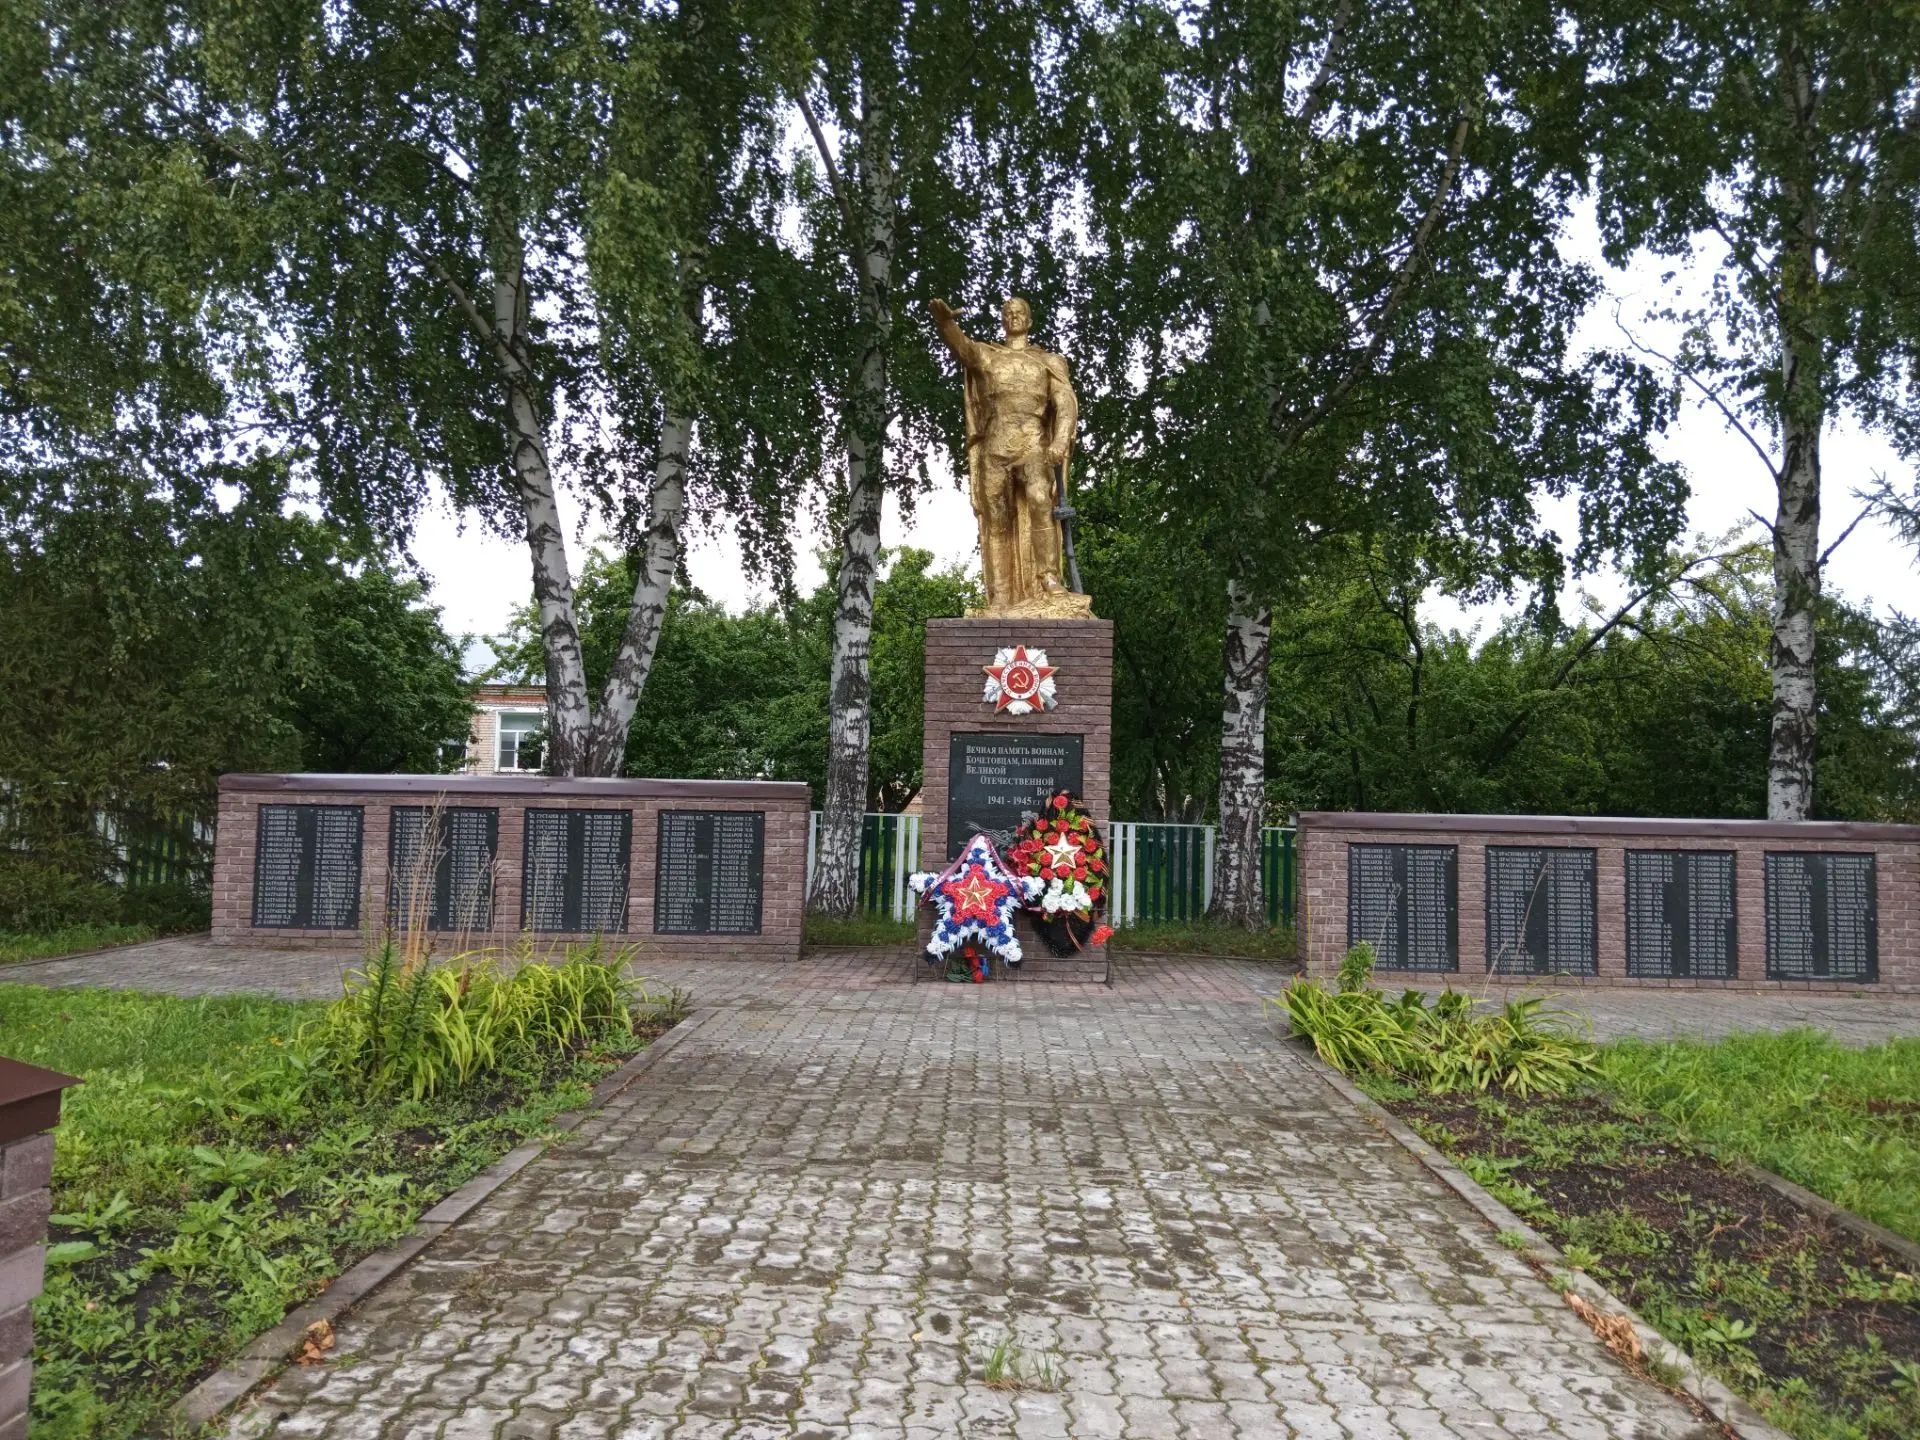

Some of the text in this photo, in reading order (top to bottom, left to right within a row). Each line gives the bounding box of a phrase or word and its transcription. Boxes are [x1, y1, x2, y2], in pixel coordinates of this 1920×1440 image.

[966, 745, 996, 754] ВЕЧНАЯ
[998, 746, 1030, 755] ПАМЯТЬ
[966, 764, 1006, 775] ВЕЛИКОЙ
[980, 776, 1054, 786] ОТЕЧЕСТВЕННОЙ
[988, 796, 1005, 804] 1941
[1014, 796, 1032, 806] 1945
